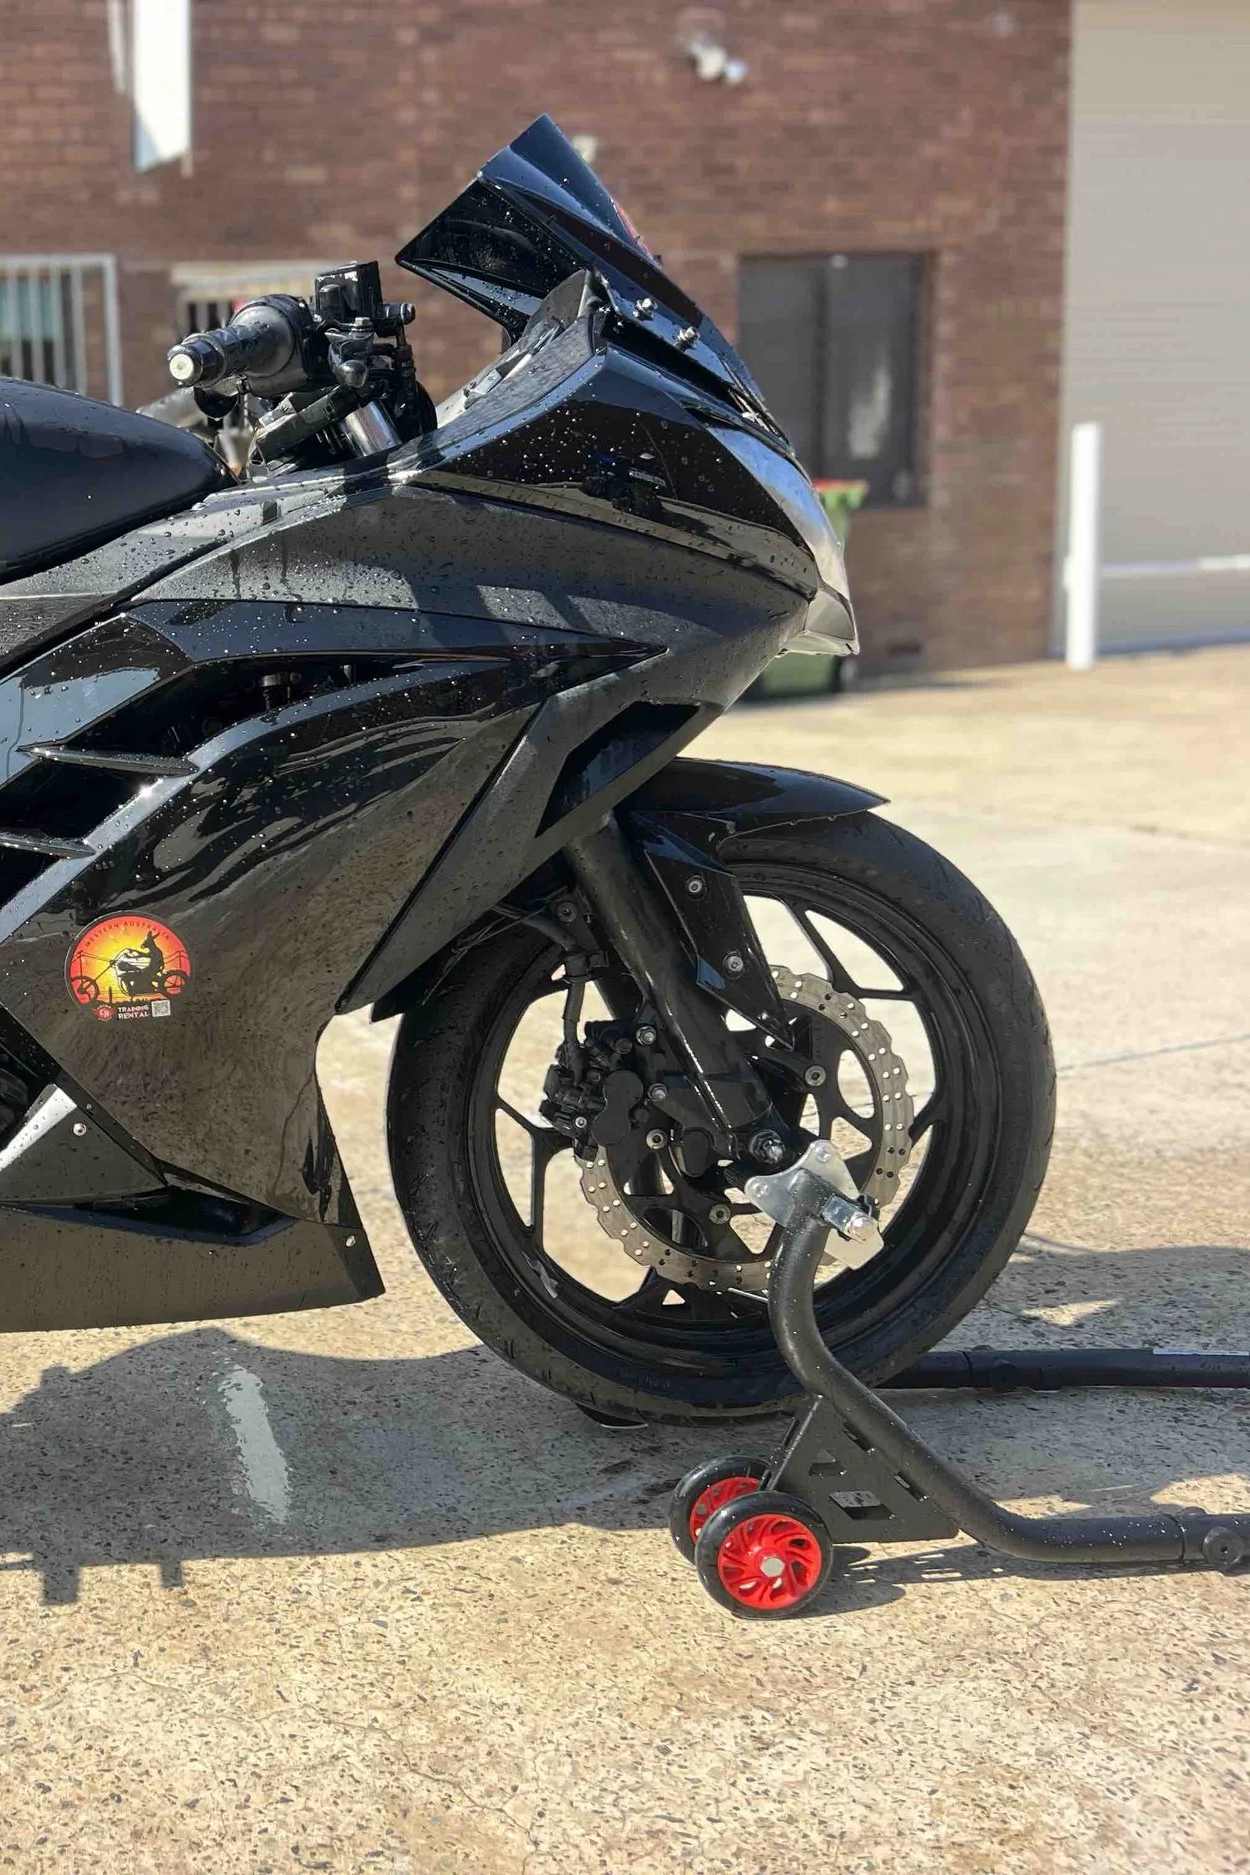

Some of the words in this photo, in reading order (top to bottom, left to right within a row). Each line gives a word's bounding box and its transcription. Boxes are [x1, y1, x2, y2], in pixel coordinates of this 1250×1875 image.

[85, 923, 119, 947] WESTERN
[123, 921, 170, 941] AUSTRALIA
[118, 1011, 149, 1020] RENTAL
